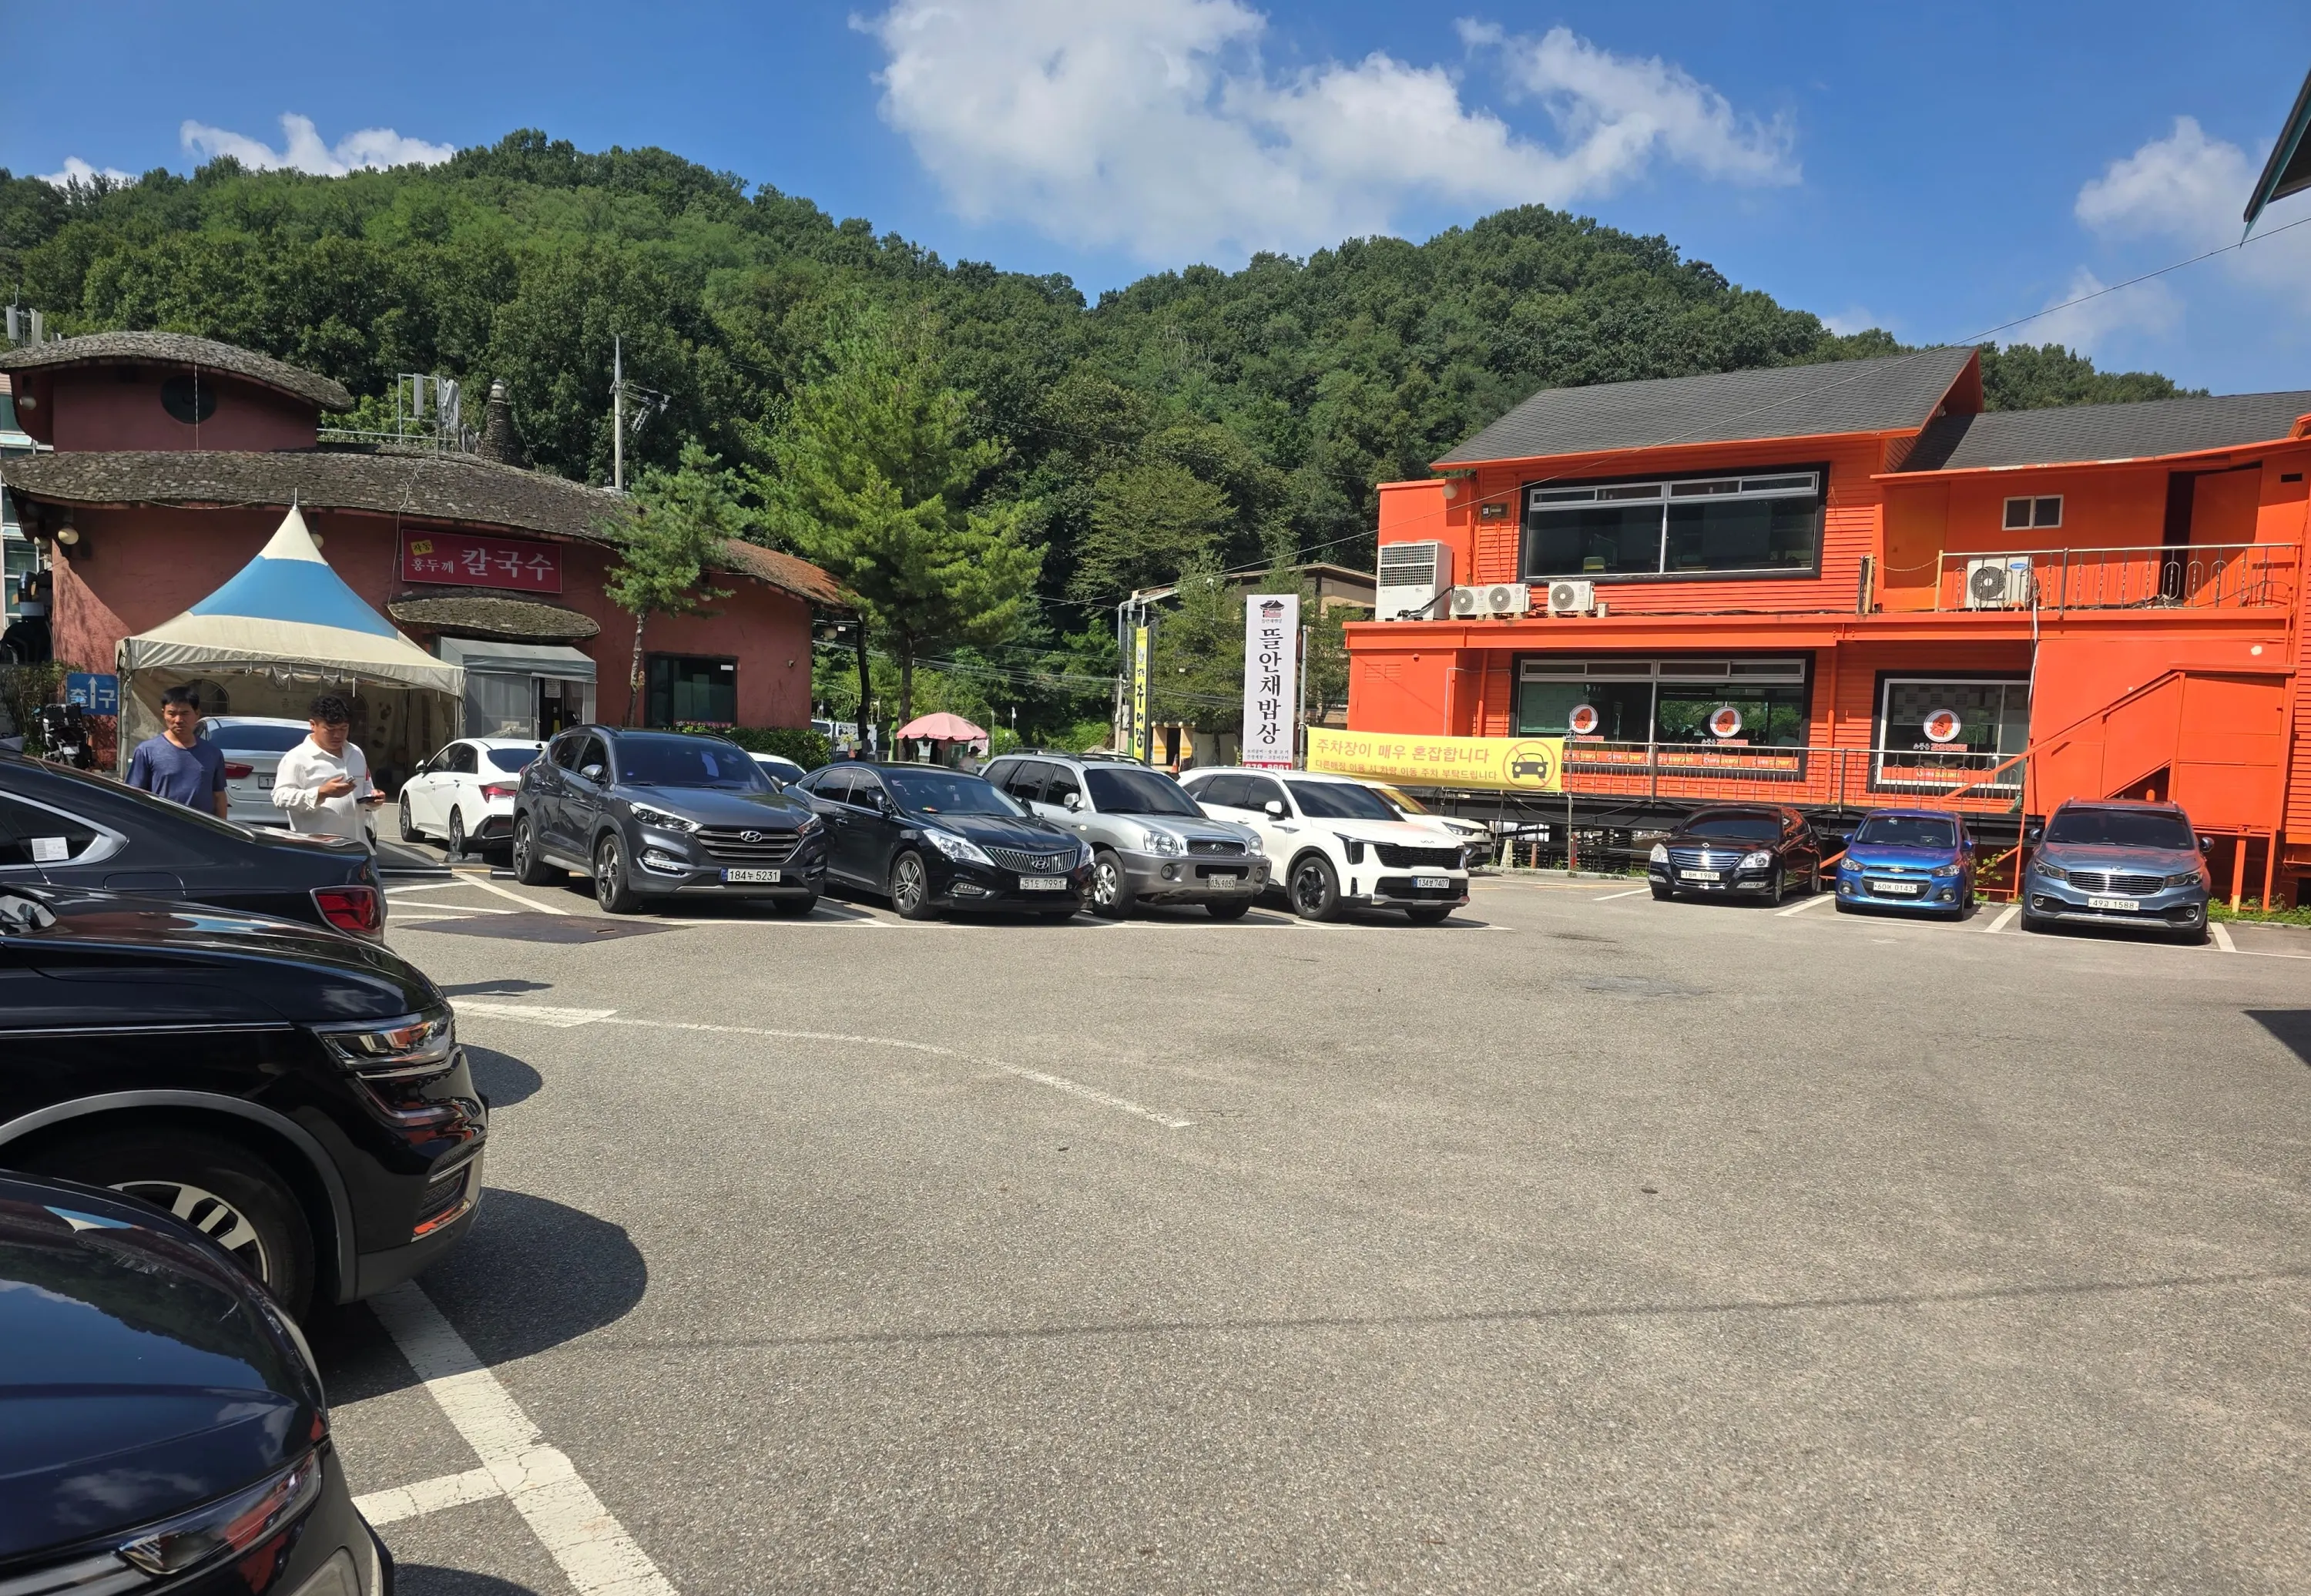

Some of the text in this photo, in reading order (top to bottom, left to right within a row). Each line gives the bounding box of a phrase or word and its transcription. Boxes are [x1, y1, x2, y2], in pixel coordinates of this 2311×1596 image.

[411, 548, 555, 581] 홍두깨 칼국수
[1256, 628, 1284, 744] 뜰안채밥상
[69, 688, 116, 709] 출구
[1135, 682, 1145, 749] 추어탕
[1316, 739, 1490, 763] 주차장이 매우 혼잡합니다
[1315, 759, 1498, 780] 다른매장 이용 시 차량 이동 주차 부탁드립니다
[730, 870, 753, 880] 184누
[756, 871, 777, 880] 5231
[1043, 880, 1062, 888] 7991
